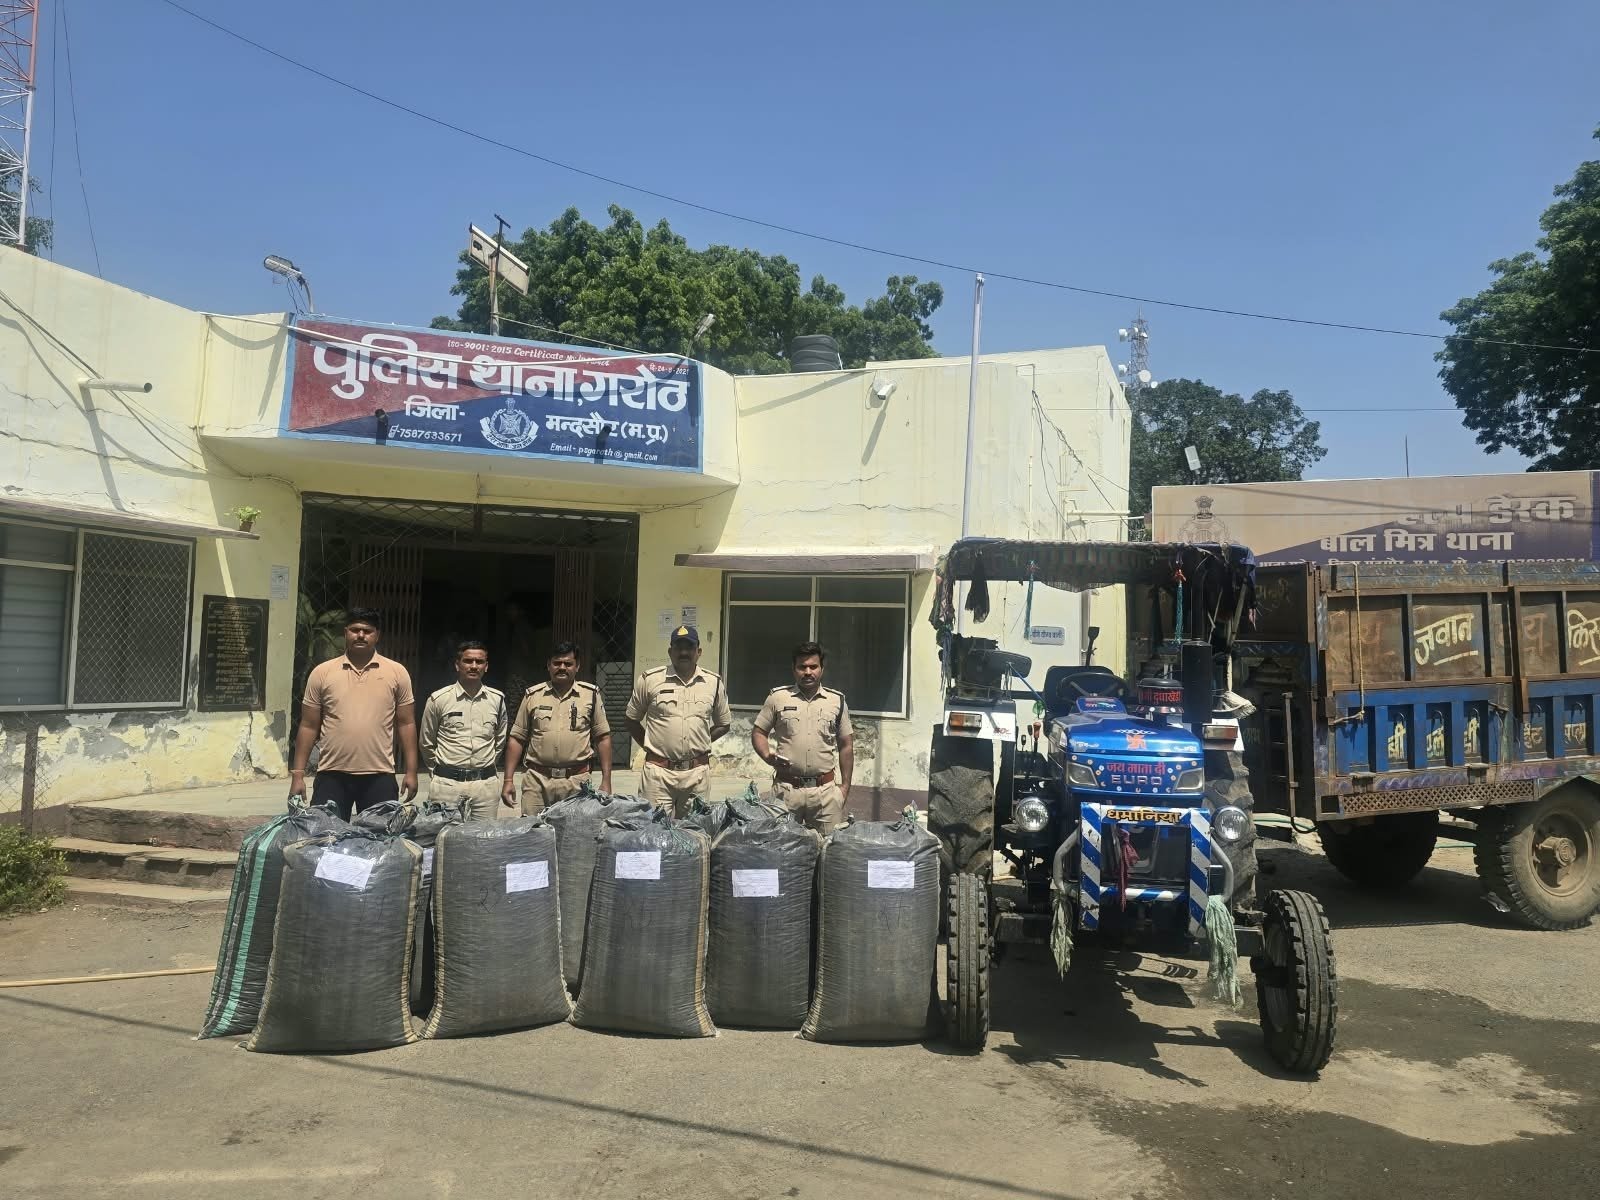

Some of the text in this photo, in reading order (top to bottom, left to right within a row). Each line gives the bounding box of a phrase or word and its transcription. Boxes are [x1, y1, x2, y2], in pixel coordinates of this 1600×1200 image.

[310, 333, 463, 400] पुलिस
[1320, 529, 1515, 552] बाल मित्र थाना
[1414, 611, 1475, 666] जवान
[1106, 761, 1166, 775] जय माता दी
[1111, 774, 1162, 785] EURO
